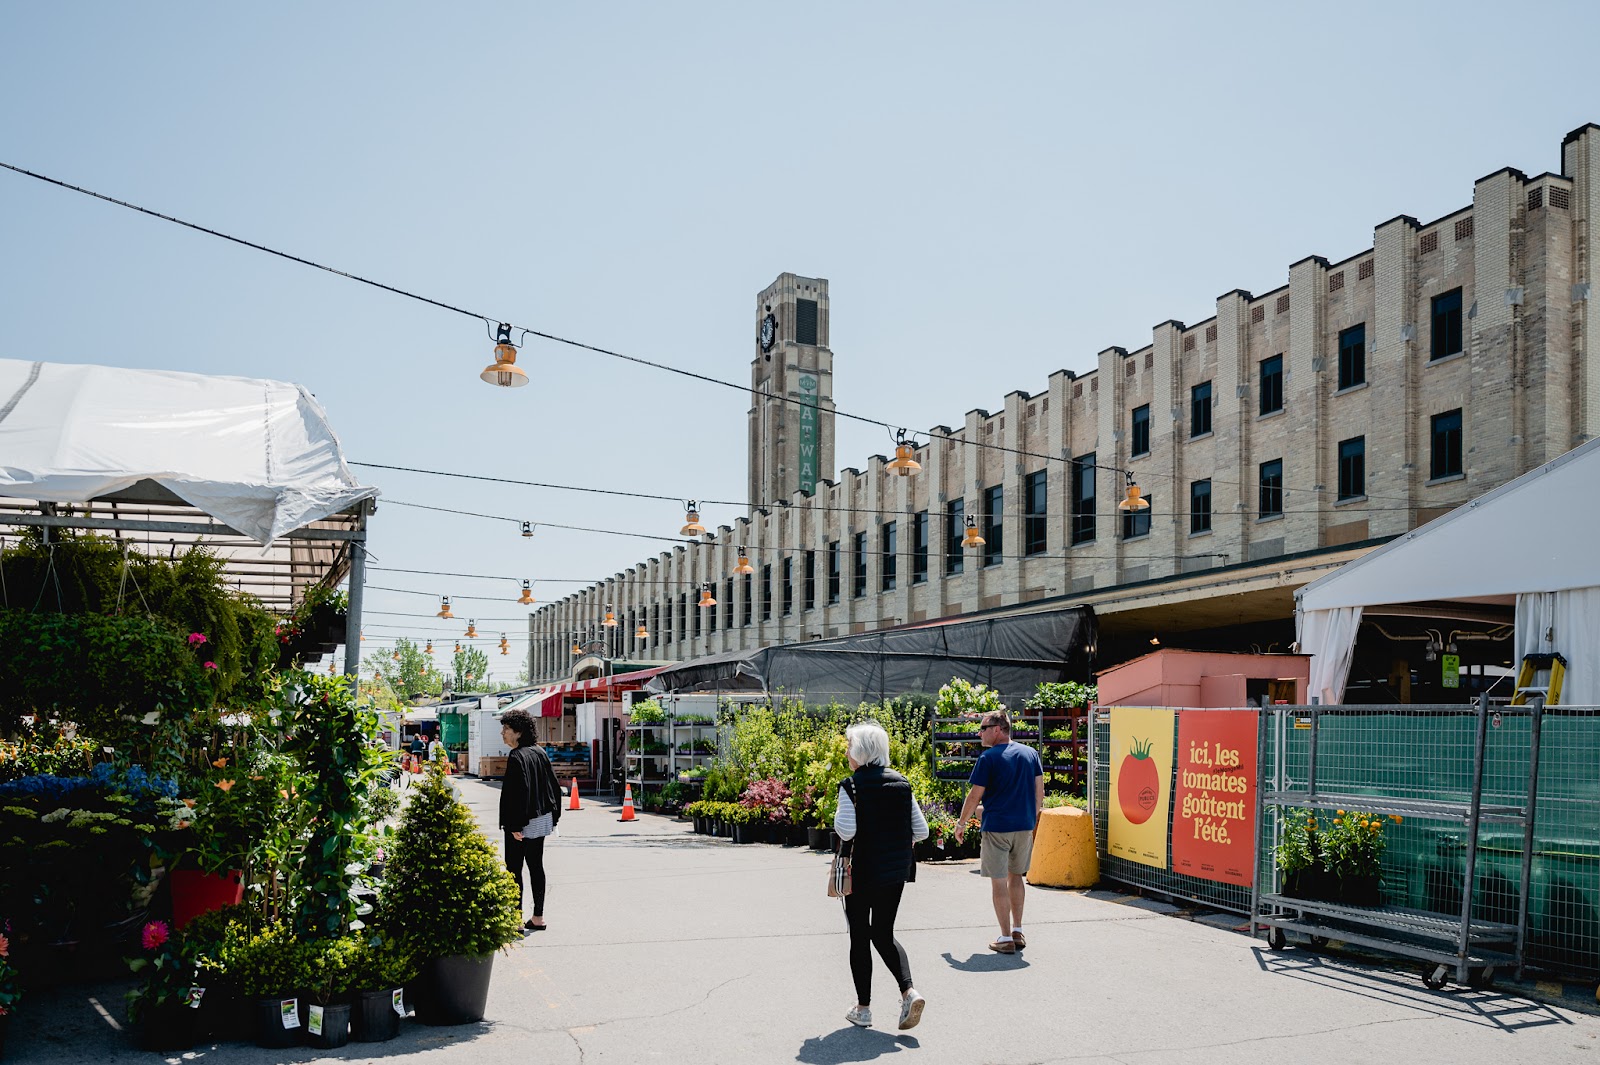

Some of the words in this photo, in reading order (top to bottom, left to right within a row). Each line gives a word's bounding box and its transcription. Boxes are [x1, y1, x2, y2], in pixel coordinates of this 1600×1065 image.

[1190, 740, 1212, 768] ici,
[1215, 743, 1240, 767] les
[1182, 768, 1247, 794] tomates
[1182, 791, 1246, 820] goûtent
[1193, 817, 1231, 845] l'été.
